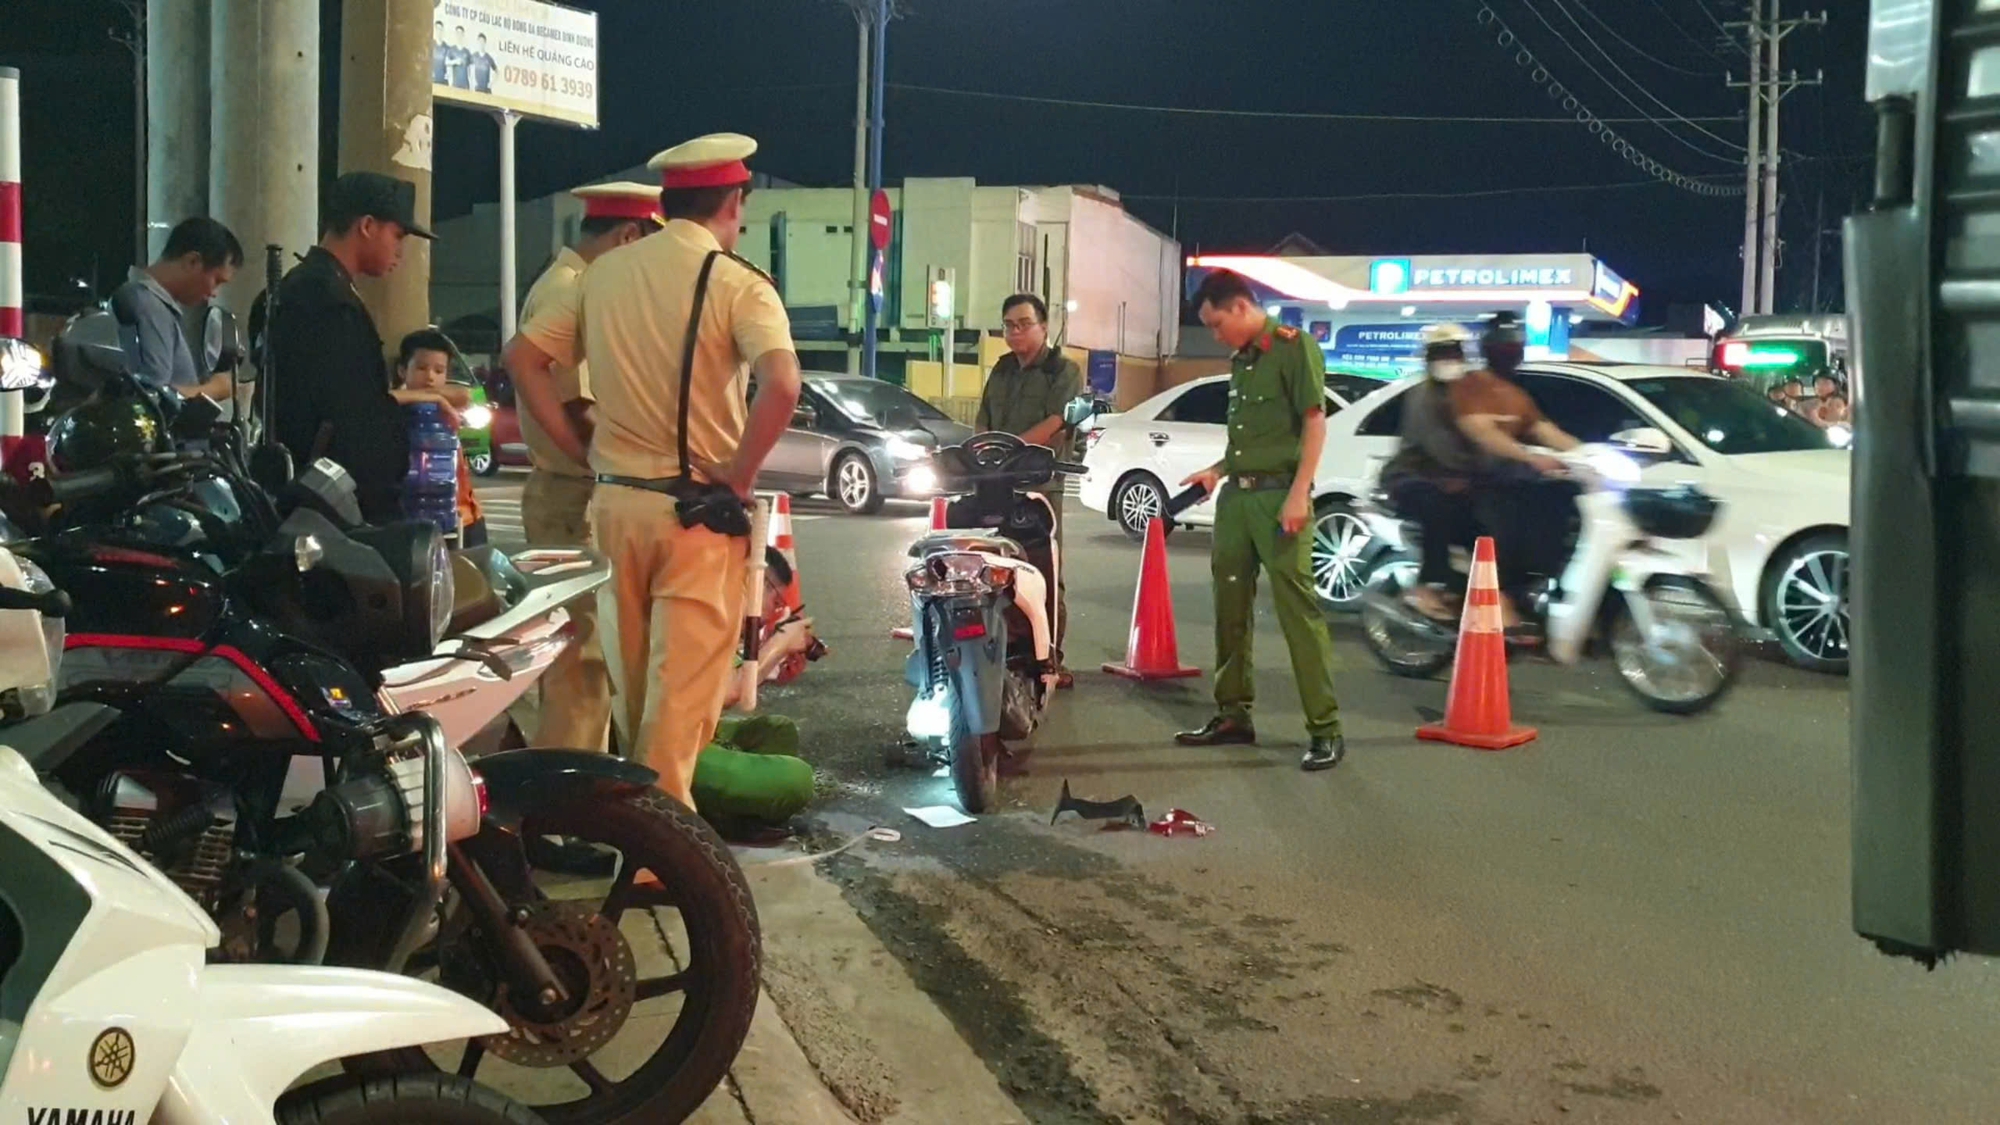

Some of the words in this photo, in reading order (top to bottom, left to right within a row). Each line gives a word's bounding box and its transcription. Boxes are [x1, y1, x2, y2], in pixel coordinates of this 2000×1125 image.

[499, 40, 520, 55] LIÊN
[504, 65, 537, 88] 0789
[541, 73, 557, 92] 61
[560, 77, 593, 99] 3939
[1413, 268, 1572, 285] PETROLIMEX
[27, 1106, 136, 1125] YAMAHA
